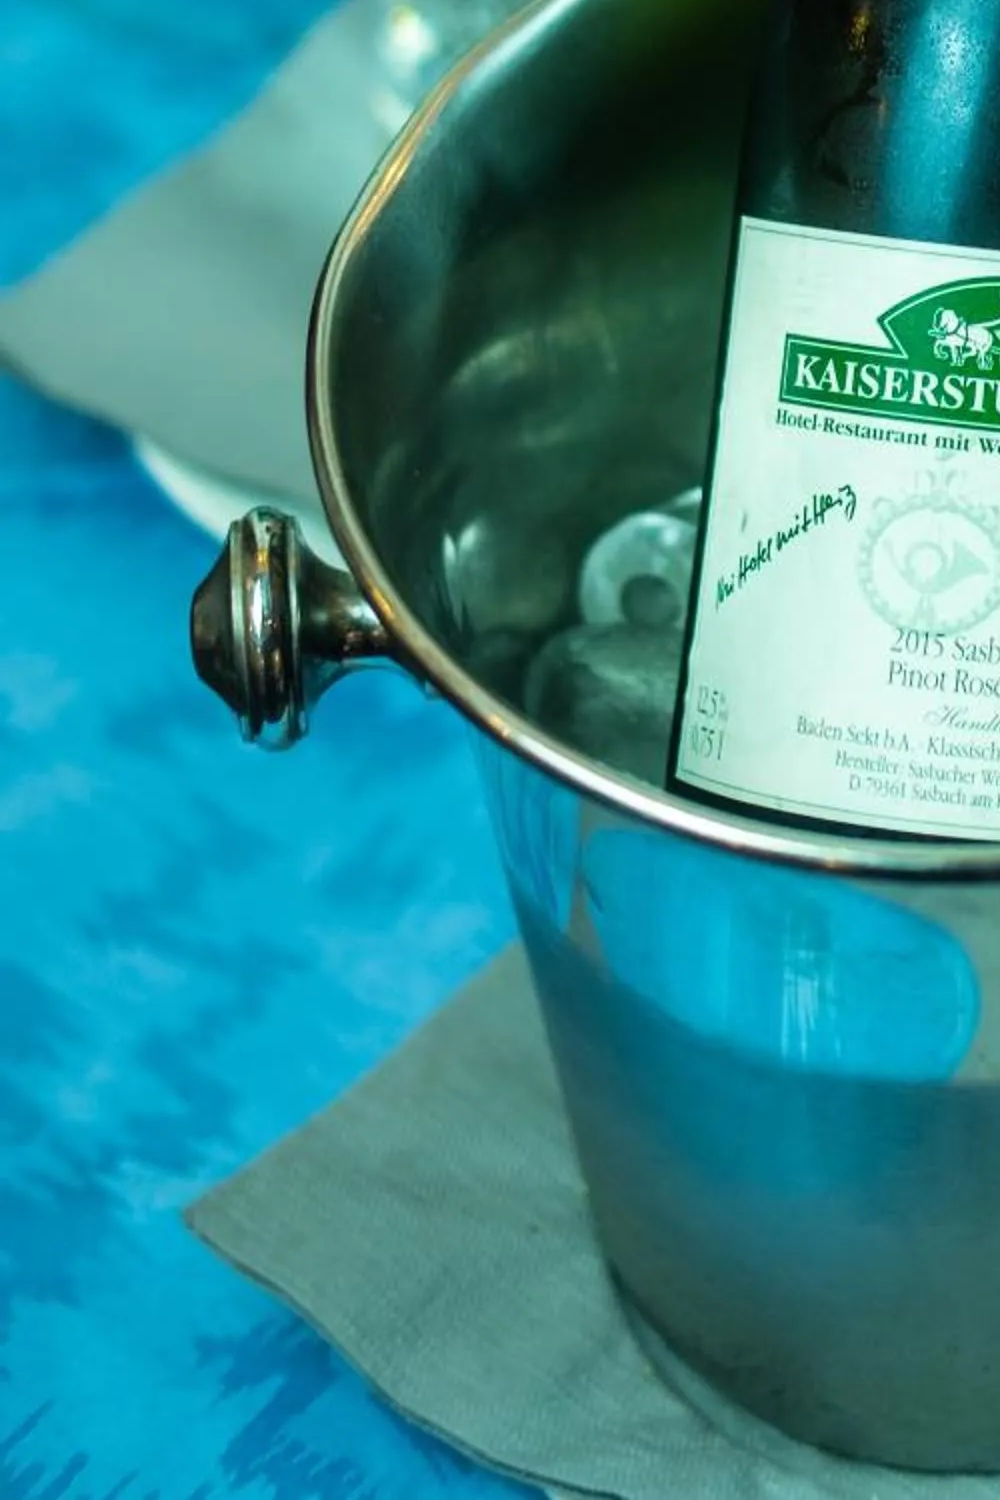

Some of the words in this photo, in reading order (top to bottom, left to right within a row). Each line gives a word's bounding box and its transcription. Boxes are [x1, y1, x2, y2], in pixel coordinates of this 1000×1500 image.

[775, 408, 928, 447] Hotel-Restaurant
[934, 433, 970, 453] mit
[889, 627, 946, 658] 2015
[888, 659, 946, 693] Pinot
[796, 715, 843, 741] Baden
[846, 724, 880, 748] Sekt
[908, 761, 976, 785] Sasbacher
[911, 784, 967, 806] Sasbach
[970, 794, 993, 808] am
